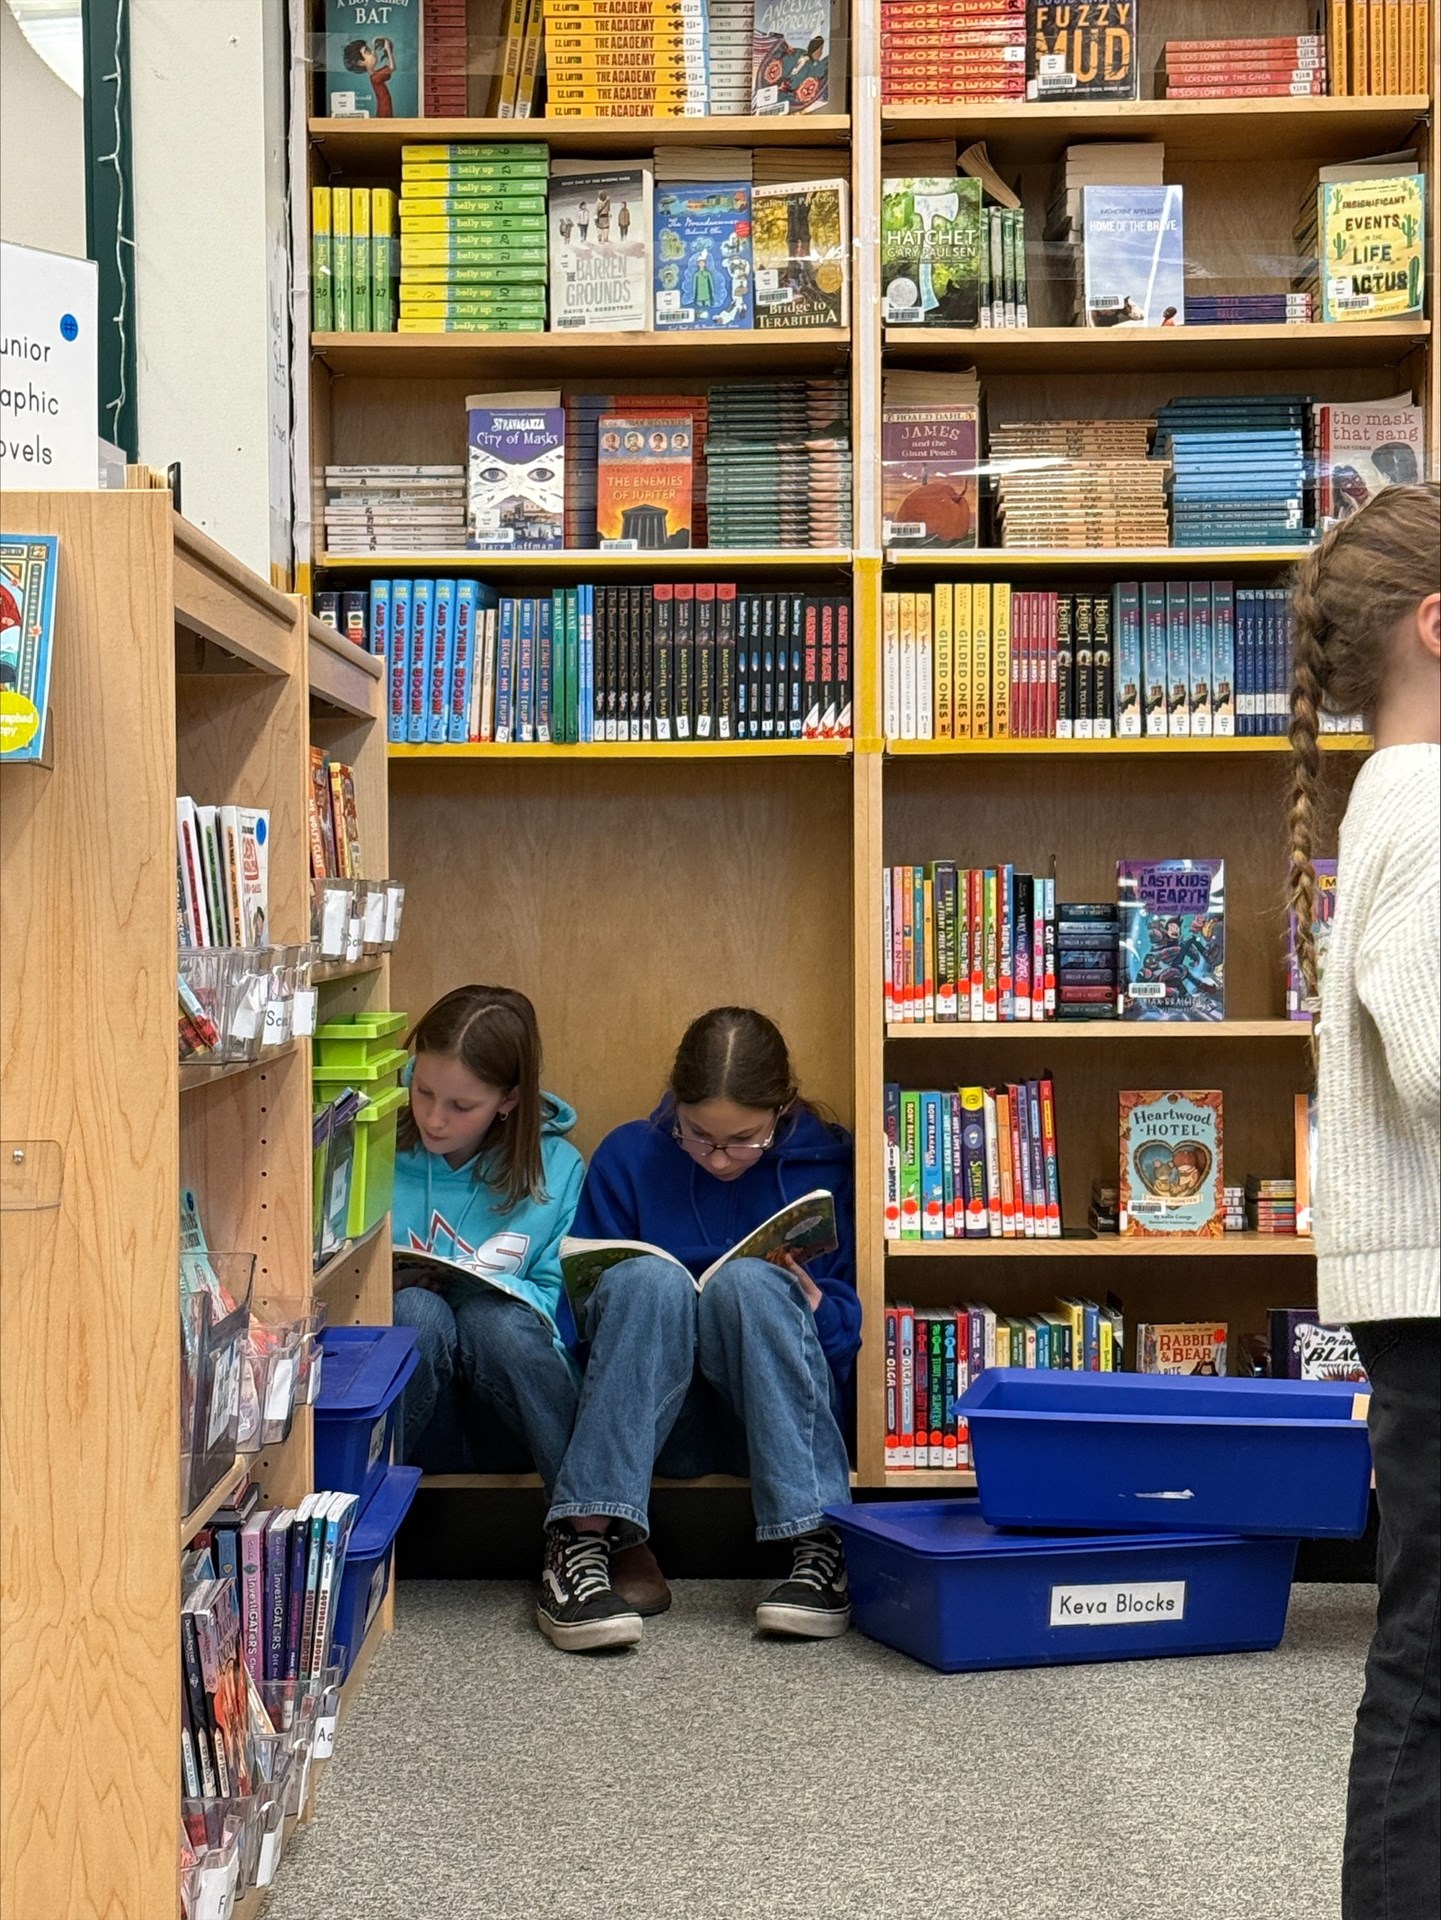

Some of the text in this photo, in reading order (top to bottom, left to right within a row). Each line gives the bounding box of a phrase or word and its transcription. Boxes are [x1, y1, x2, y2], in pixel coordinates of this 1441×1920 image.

[355, 7, 392, 24] BAT
[891, 1, 1007, 15] FRONT DESK
[1036, 3, 1130, 30] FUZZY
[595, 20, 610, 32] THE
[610, 20, 655, 32] ACADEMY
[1035, 28, 1130, 82] MUD
[598, 87, 656, 100] THE ACADEMY
[458, 166, 494, 176] belly up
[1342, 196, 1406, 209] INSIGNIFICANT
[1090, 221, 1115, 232] HOME
[1116, 220, 1126, 232] OF
[1130, 220, 1146, 231] THE
[1345, 214, 1400, 232] EVENTS
[888, 230, 976, 245] HATCHET
[887, 247, 976, 258] GARY PAULSEN
[1354, 245, 1392, 265] LIFE
[576, 256, 628, 281] BARREN
[1352, 271, 1408, 296] ACTUS
[566, 280, 631, 306] GROUNDS
[769, 301, 826, 315] Bridge to
[756, 309, 838, 328] TERABITHIA
[0, 336, 51, 362] unior
[0, 382, 59, 417] aphic
[491, 418, 545, 432] STRAVAGANZA
[1332, 412, 1414, 426] the mask
[477, 432, 558, 448] City of Masks
[901, 426, 960, 440] JAMES
[1332, 427, 1418, 442] that sang
[0, 434, 52, 465] ovels
[912, 440, 929, 448] and
[901, 450, 958, 458] Giant Peach
[608, 476, 682, 486] THE ENEMIES
[612, 490, 676, 500] OF JUPITER
[396, 604, 405, 626] AND
[1076, 599, 1091, 644] HOBBIT
[939, 630, 948, 678] GILDED
[720, 649, 728, 687] DAUGHTER
[976, 630, 985, 718] GILDED ONES
[499, 639, 510, 725] BECAUSE MR TERUPT
[939, 682, 948, 718] ONES
[500, 728, 507, 739] 5
[540, 727, 548, 737] 2
[631, 724, 638, 736] 8
[660, 722, 666, 733] 2
[680, 720, 685, 730] 3
[700, 719, 708, 730] 4
[721, 720, 727, 730] 5
[314, 844, 324, 868] CLASS
[1140, 873, 1210, 888] LAST KIDS
[946, 888, 954, 914] THE
[1140, 888, 1208, 904] ON EARTH
[1016, 914, 1027, 932] VERY
[938, 931, 946, 949] CREEK
[946, 920, 954, 948] TINY
[1017, 934, 1027, 952] VERY
[1046, 926, 1054, 975] CAT RUN
[938, 950, 946, 974] LIBRARY
[1001, 956, 1010, 976] TWO
[1133, 1108, 1212, 1126] Heartwood
[906, 1103, 914, 1164] RORY BRANAGAN
[1146, 1124, 1200, 1136] HOTEL
[888, 1166, 896, 1202] UNIVERSE
[1160, 1334, 1214, 1351] RABBIT
[1160, 1348, 1212, 1362] & BEAR
[886, 1358, 896, 1386] OLGA
[902, 1358, 910, 1386] OLGA
[1060, 1592, 1174, 1614] Keva Blocks
